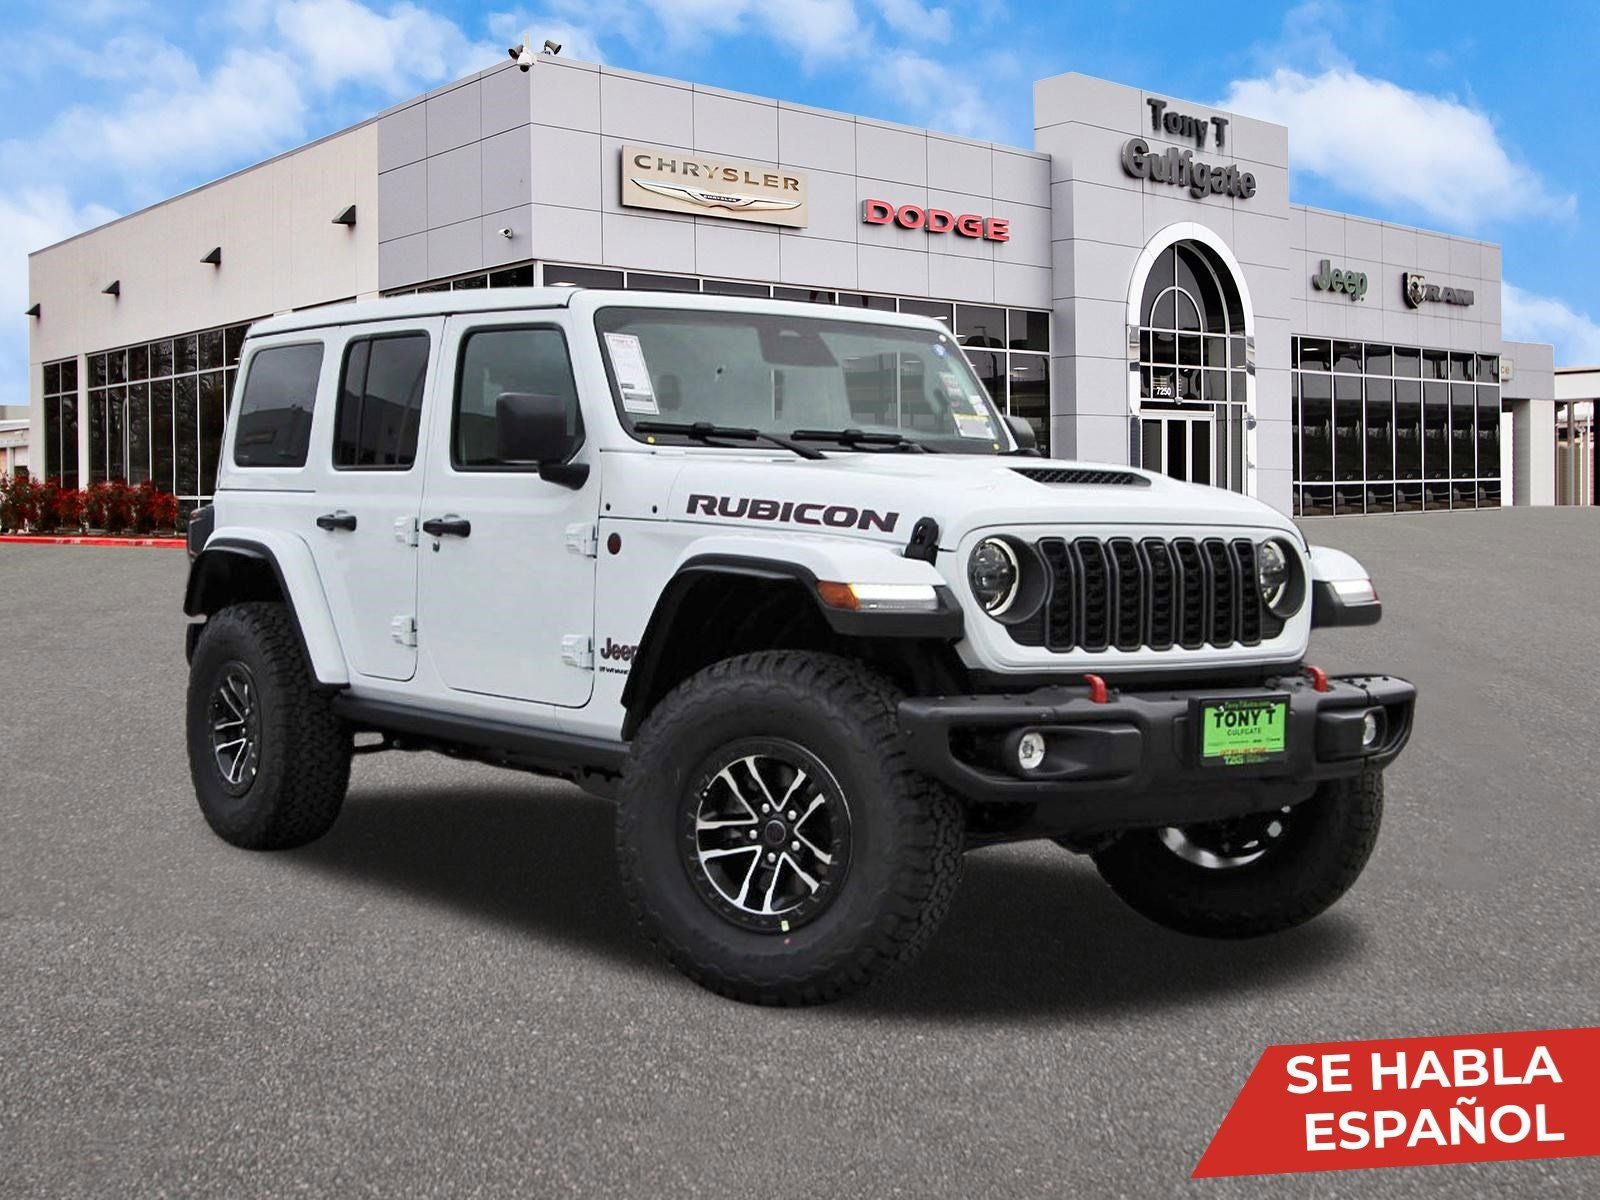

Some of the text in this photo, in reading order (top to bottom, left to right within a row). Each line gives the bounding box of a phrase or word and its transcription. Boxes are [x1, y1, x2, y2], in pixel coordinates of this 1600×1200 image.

[1147, 98, 1229, 148] Tony T
[633, 154, 800, 191] CHRYSLER
[1121, 138, 1257, 199] Gulfgate
[862, 199, 1010, 243] DODGE
[1312, 259, 1368, 302] Jeep
[1423, 283, 1475, 306] RAM
[1156, 386, 1172, 396] 7250
[686, 494, 900, 533] RUBICON
[1214, 709, 1276, 728] TONY T
